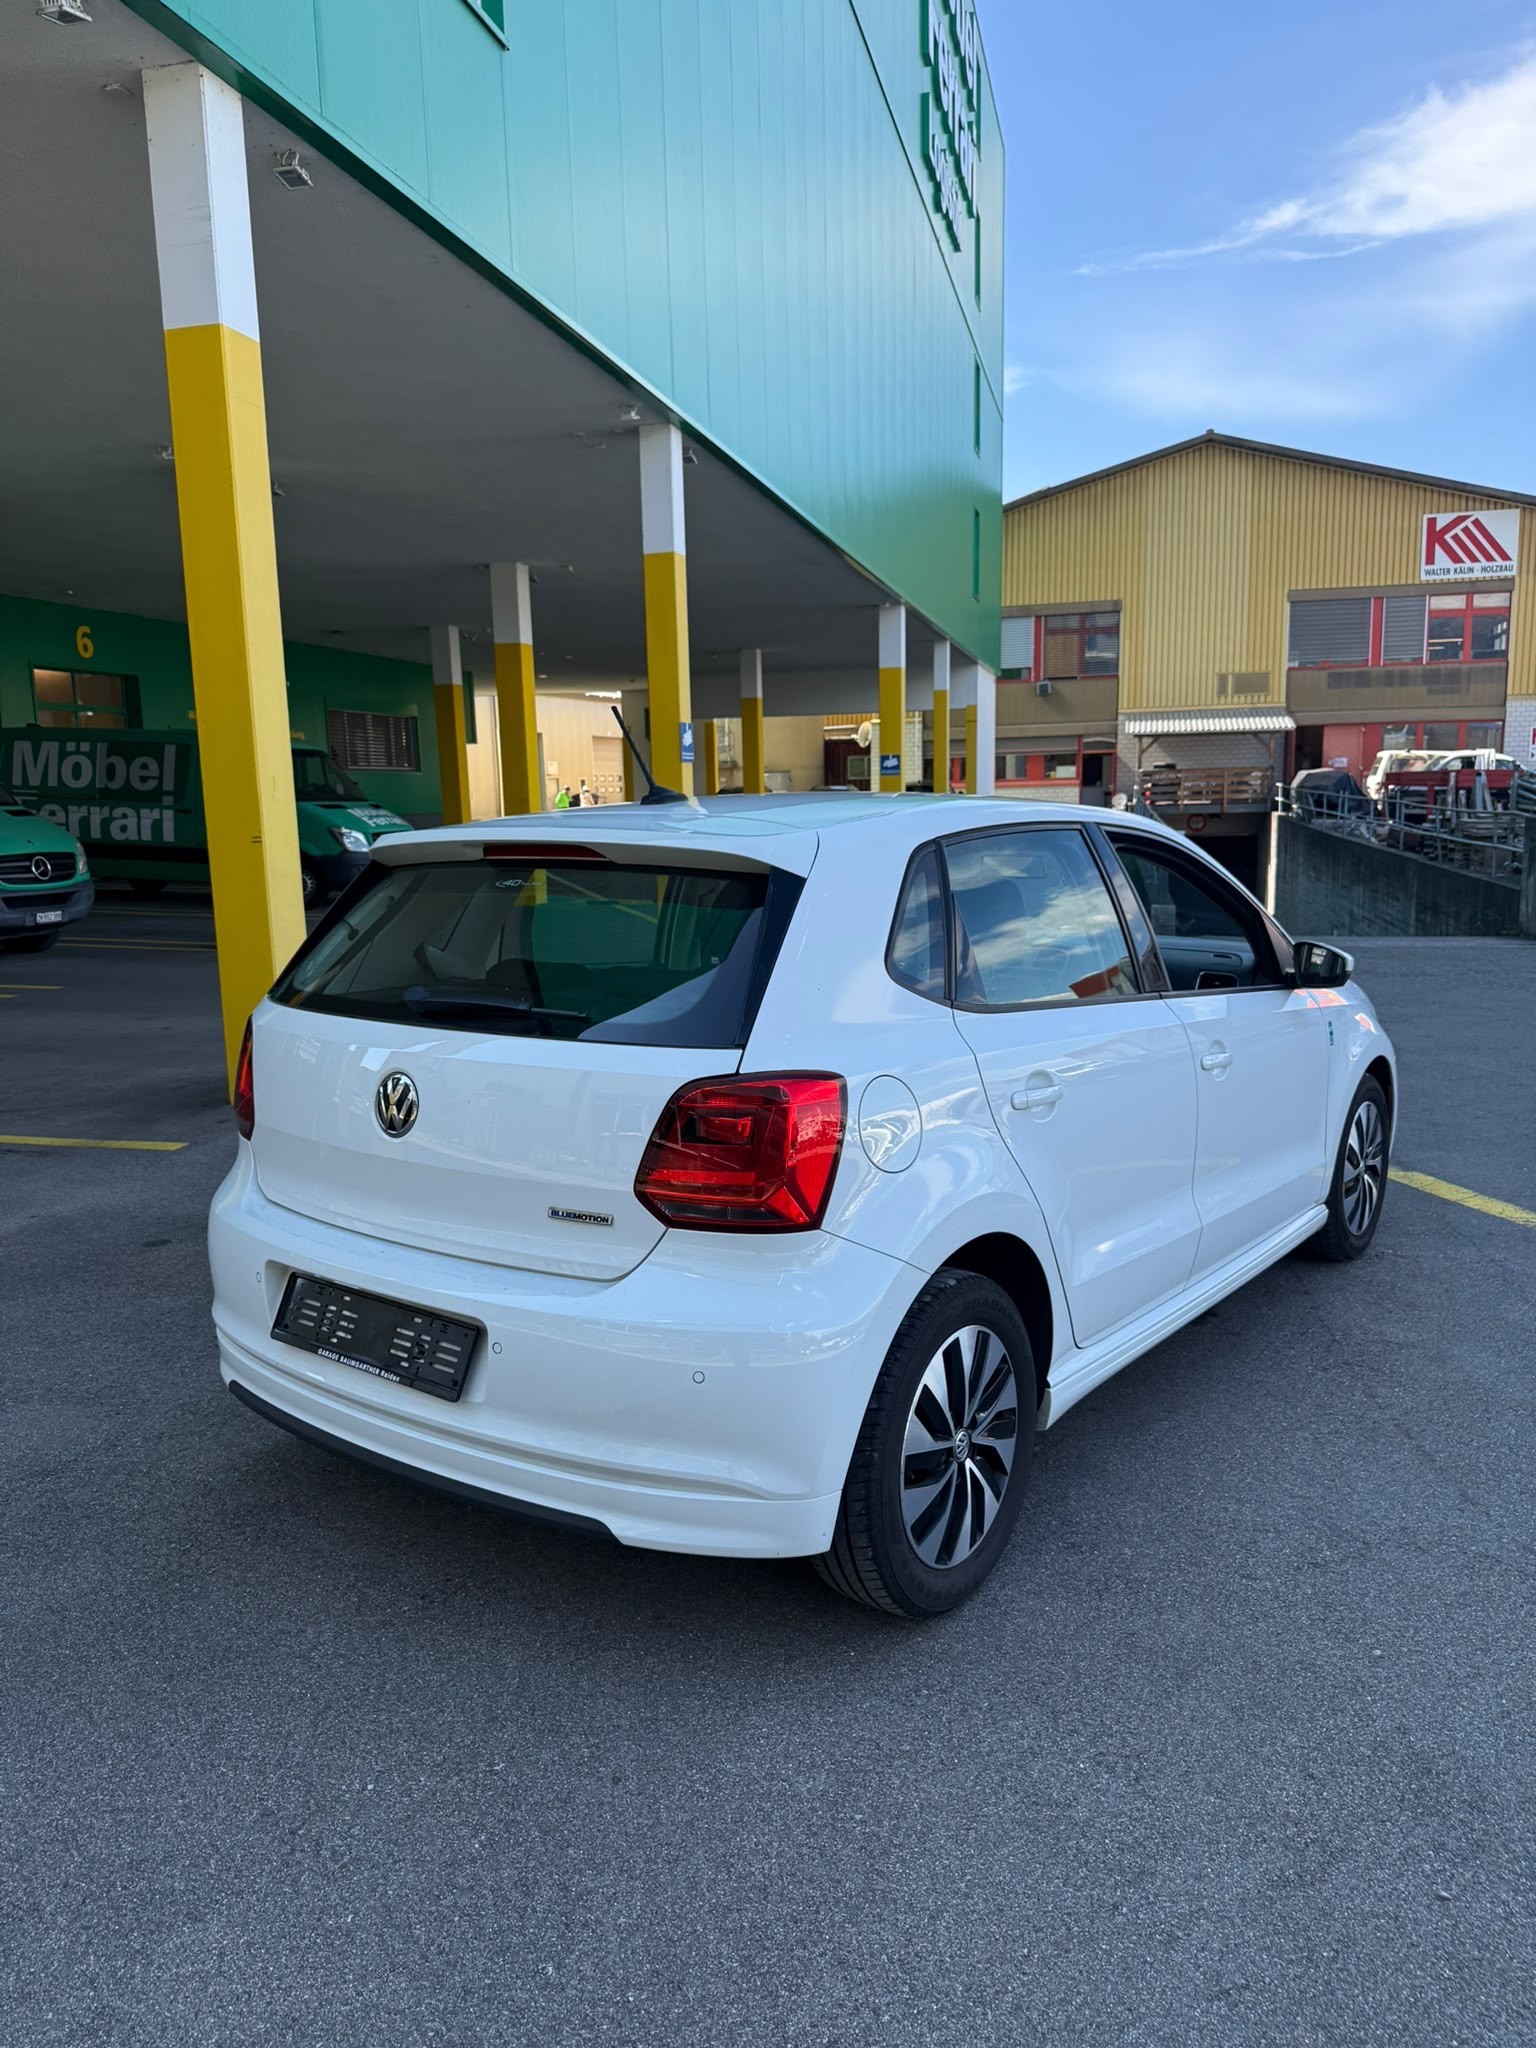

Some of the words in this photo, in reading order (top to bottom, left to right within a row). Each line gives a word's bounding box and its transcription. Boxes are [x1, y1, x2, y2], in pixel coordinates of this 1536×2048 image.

[1424, 567, 1451, 577] WALTER
[1480, 564, 1514, 574] HOLZBAU
[76, 625, 94, 659] 6
[12, 740, 176, 791] Möbel
[12, 789, 175, 842] errari
[550, 1209, 610, 1224] BLUEMOTION
[317, 1347, 340, 1361] GARAGE
[339, 1355, 380, 1375] BAUMGARTNER
